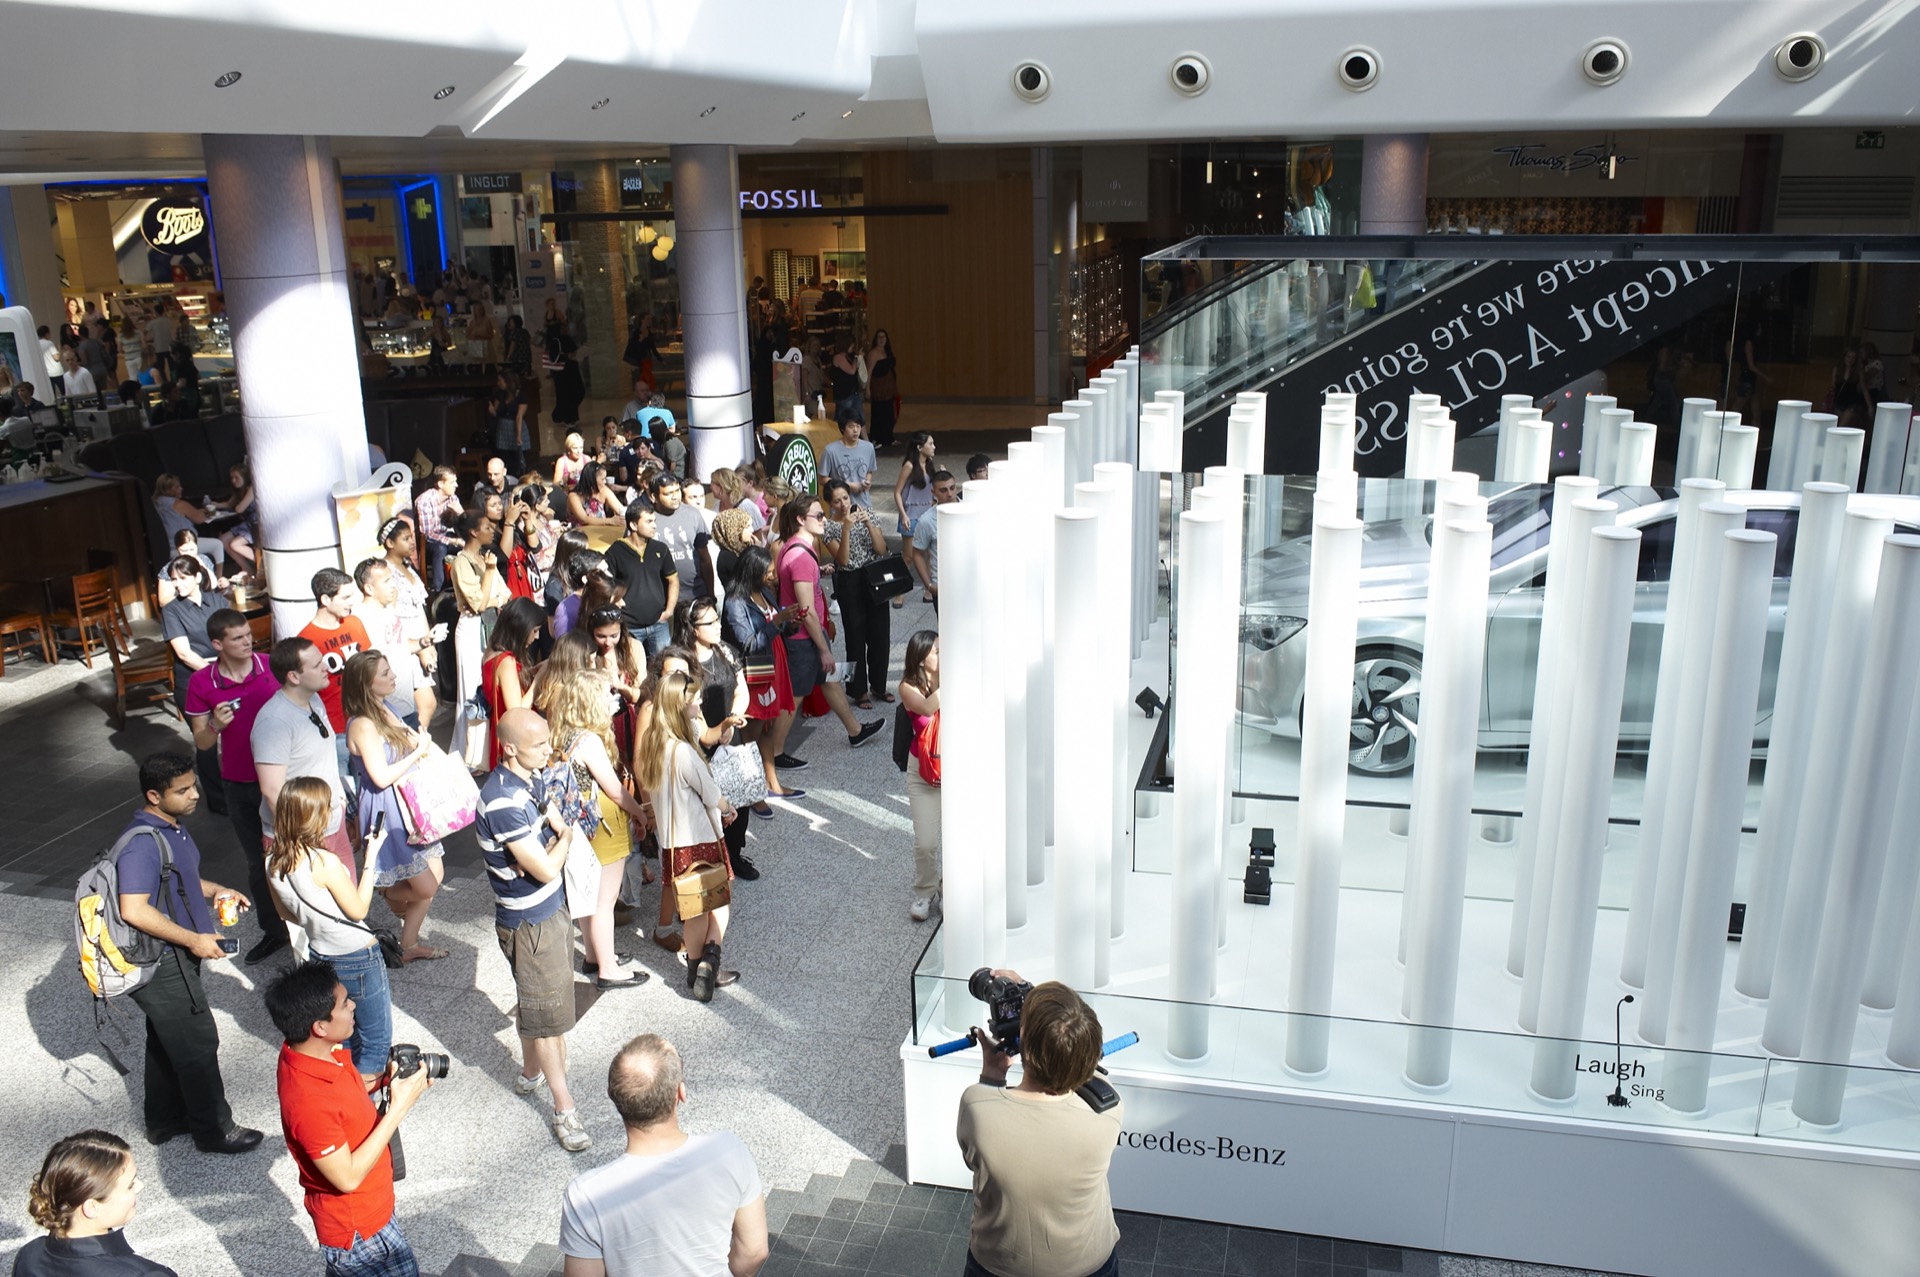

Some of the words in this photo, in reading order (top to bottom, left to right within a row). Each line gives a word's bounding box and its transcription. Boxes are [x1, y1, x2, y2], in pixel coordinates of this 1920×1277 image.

[1493, 144, 1565, 170] Thomas
[470, 175, 510, 188] INGLOT
[739, 189, 823, 210] FOSSIL
[152, 206, 205, 246] Boots
[324, 636, 339, 651] I'M
[339, 632, 353, 645] AN
[1575, 1053, 1646, 1081] Laugh
[1630, 1083, 1665, 1102] Sing
[1116, 1130, 1287, 1167] rcedes-Benz
